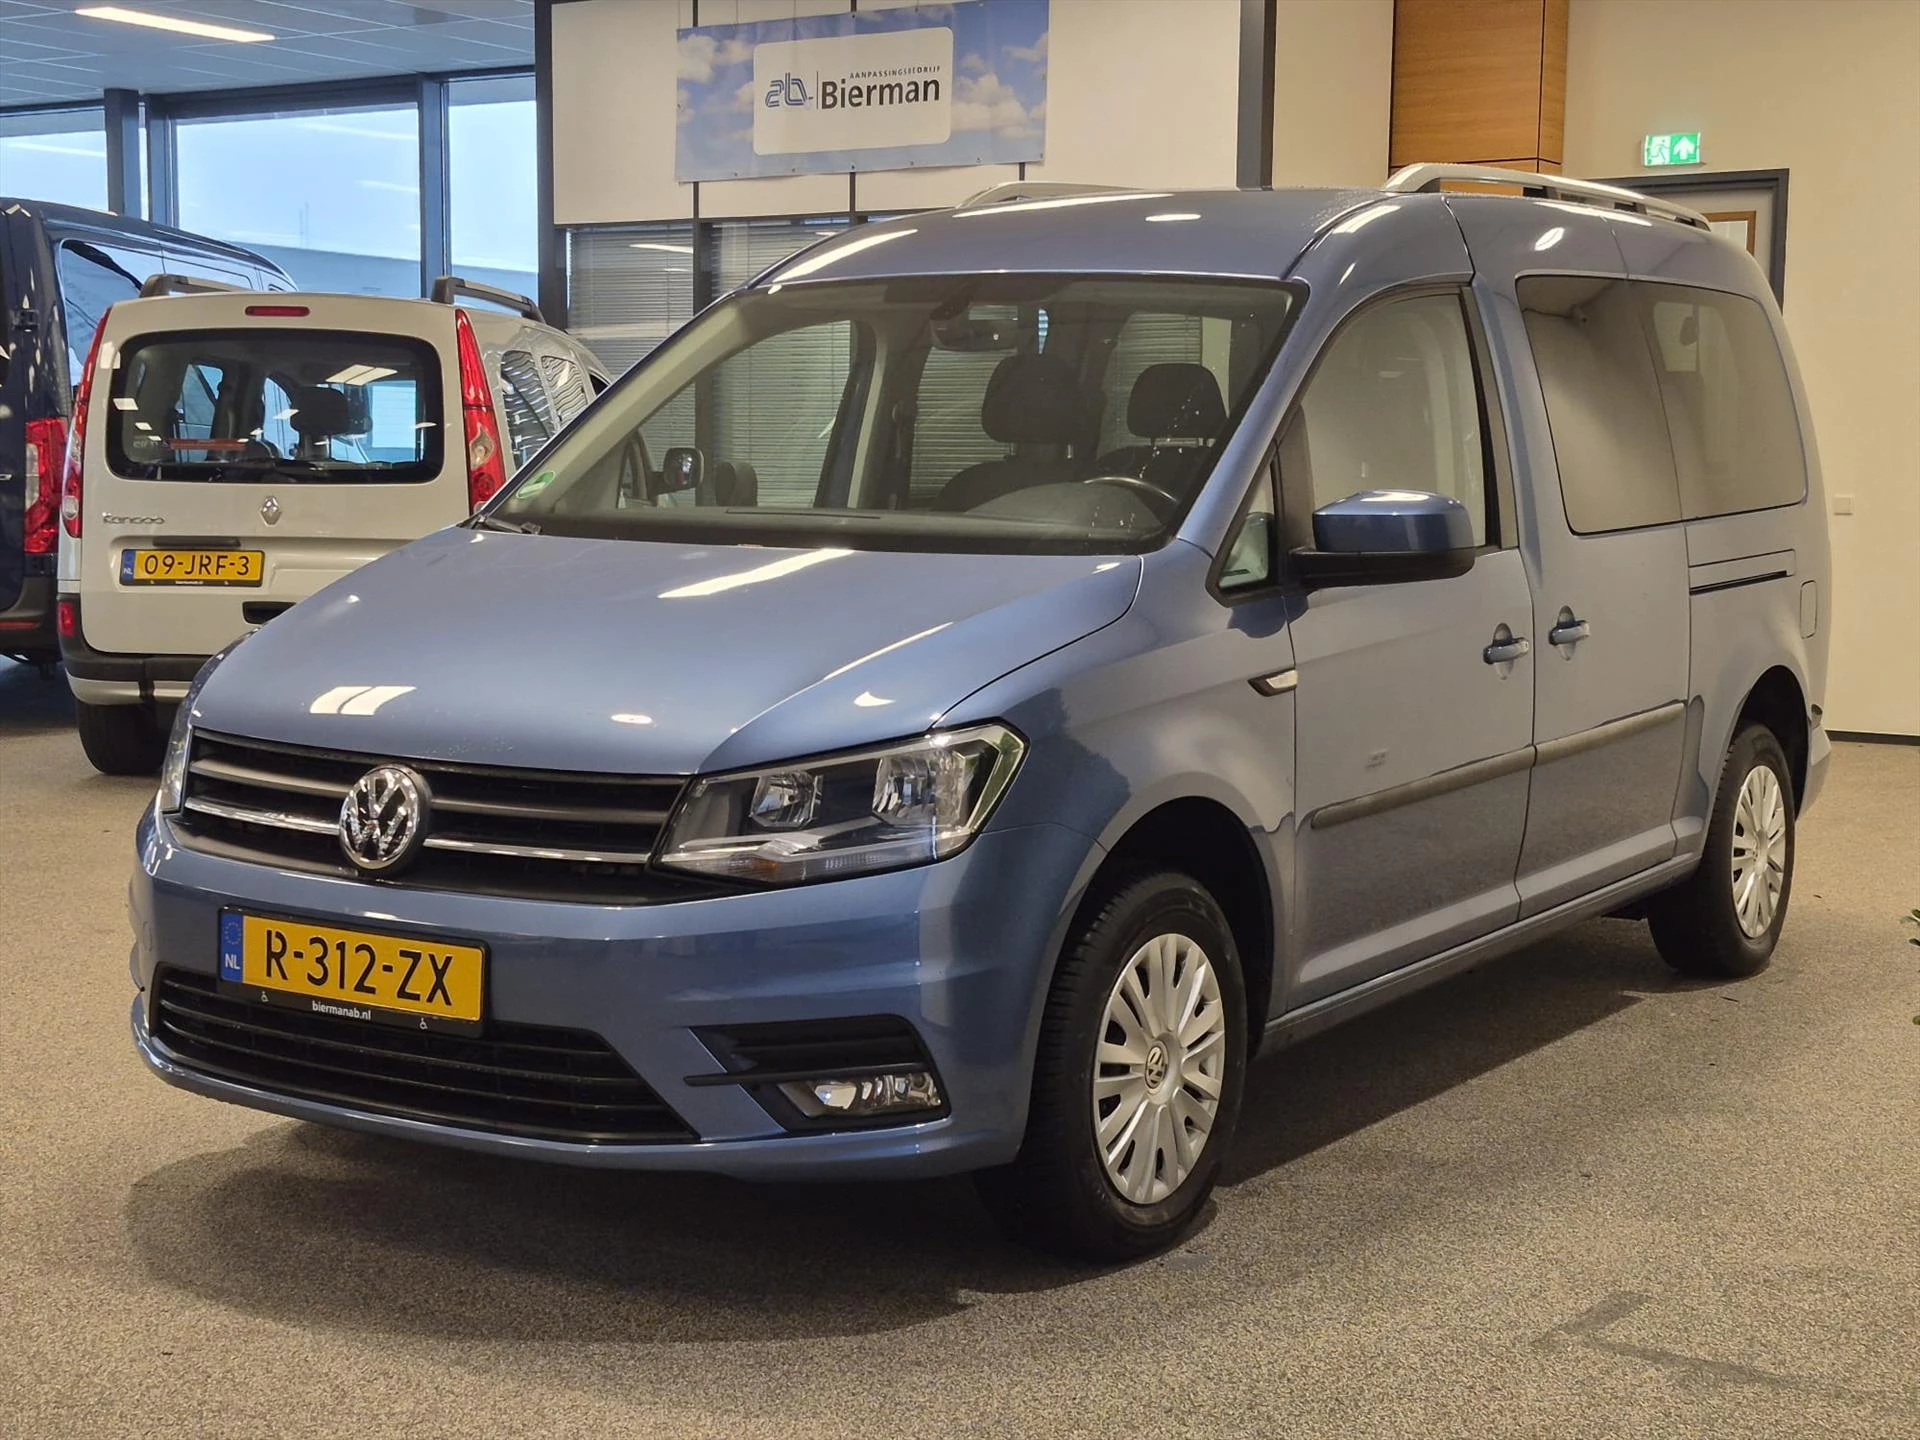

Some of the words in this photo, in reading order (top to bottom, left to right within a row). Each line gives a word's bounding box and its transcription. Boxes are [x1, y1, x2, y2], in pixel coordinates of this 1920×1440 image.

[850, 65, 941, 79] AANPASSINGSBEDRIJF
[821, 78, 940, 110] Bierman
[123, 567, 134, 575] NL
[144, 554, 250, 576] 09-JRF-3
[224, 953, 241, 970] NL
[265, 929, 453, 1007] R-312-ZX
[312, 1000, 372, 1021] biermanab.nl
